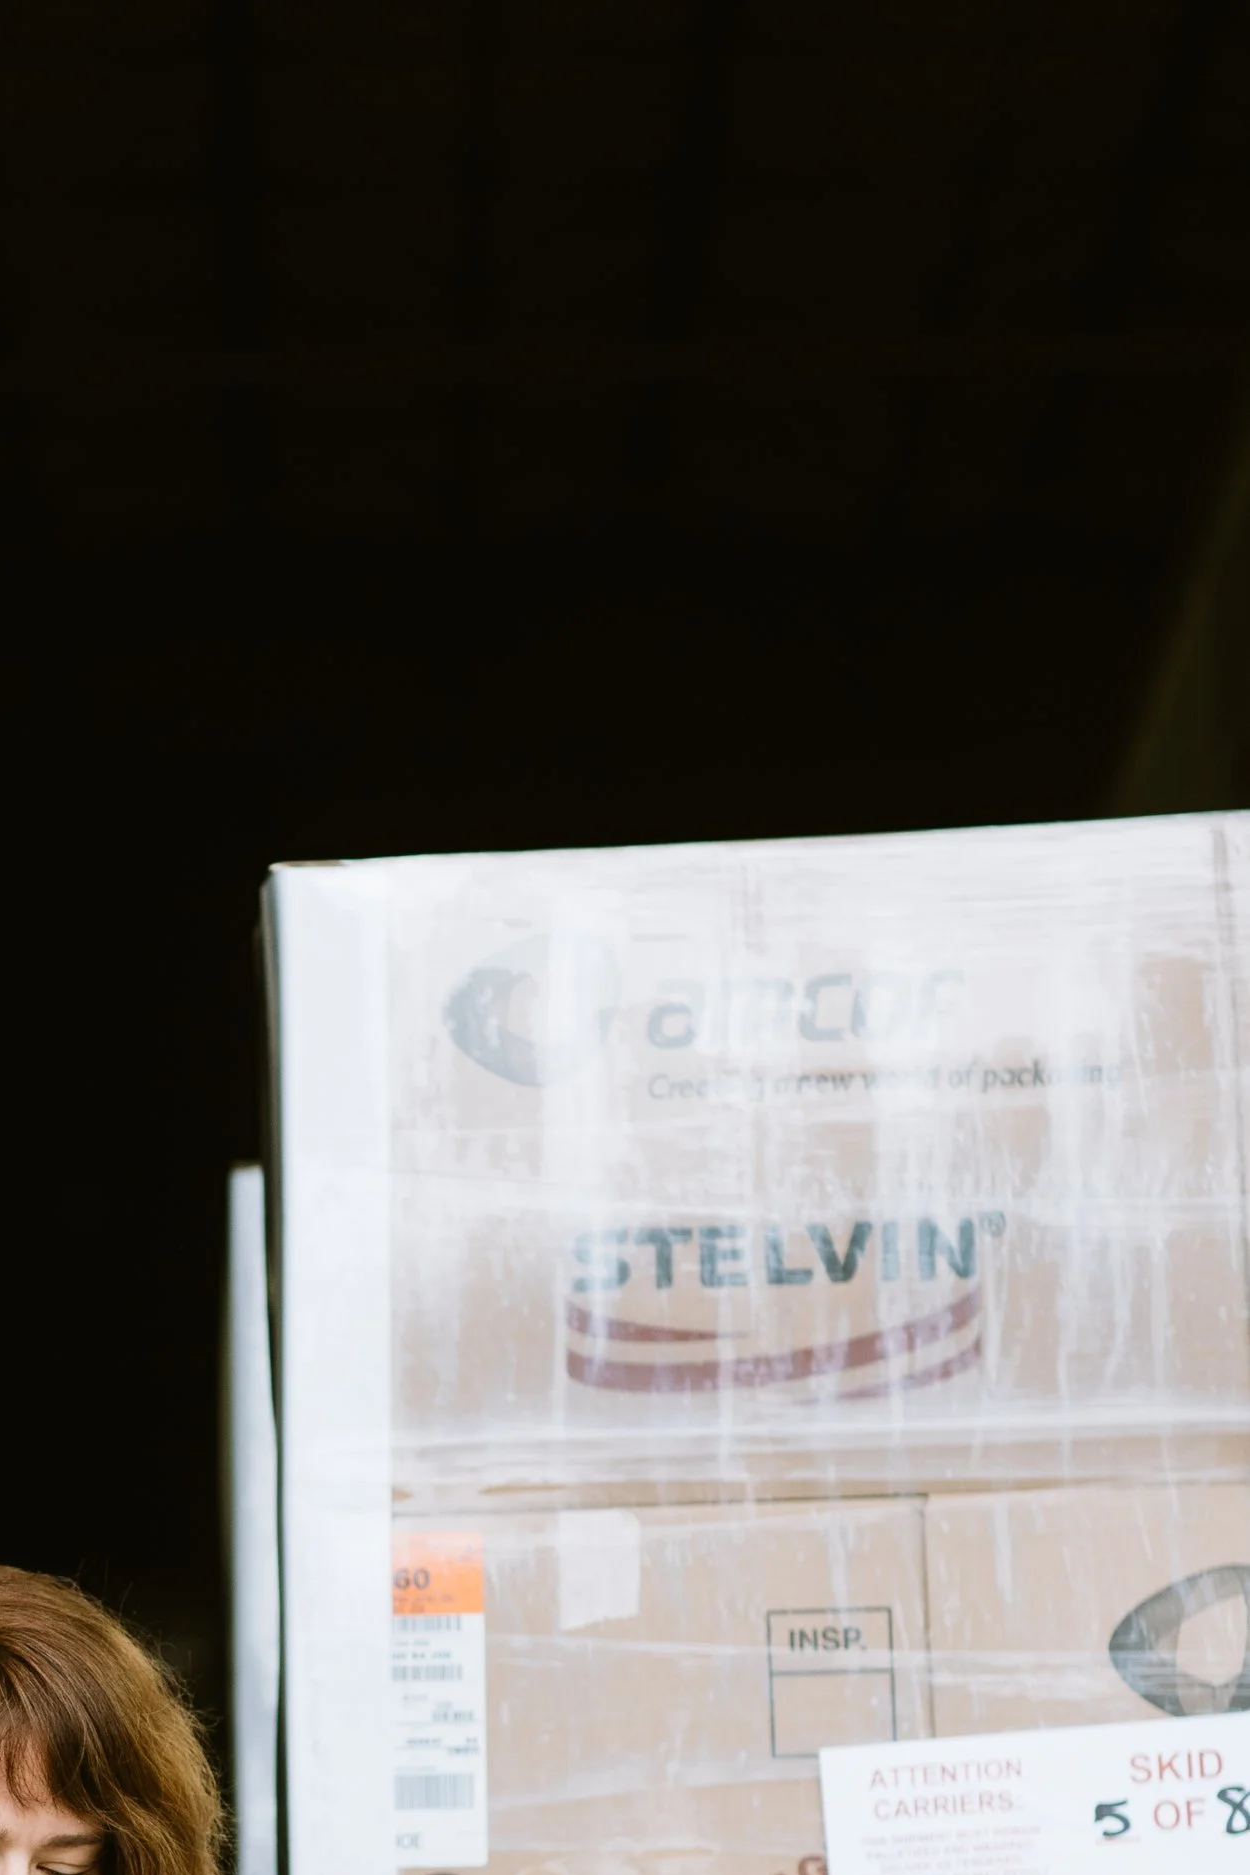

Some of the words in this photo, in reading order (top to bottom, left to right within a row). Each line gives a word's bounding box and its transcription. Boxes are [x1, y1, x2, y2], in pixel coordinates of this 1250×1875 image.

[788, 1625, 867, 1652] INSP.
[870, 1759, 1023, 1790] ATTENTION
[1129, 1750, 1224, 1785] SKID
[1094, 1799, 1132, 1838] 5
[1153, 1798, 1207, 1831] OF
[1216, 1785, 1250, 1835] 8
